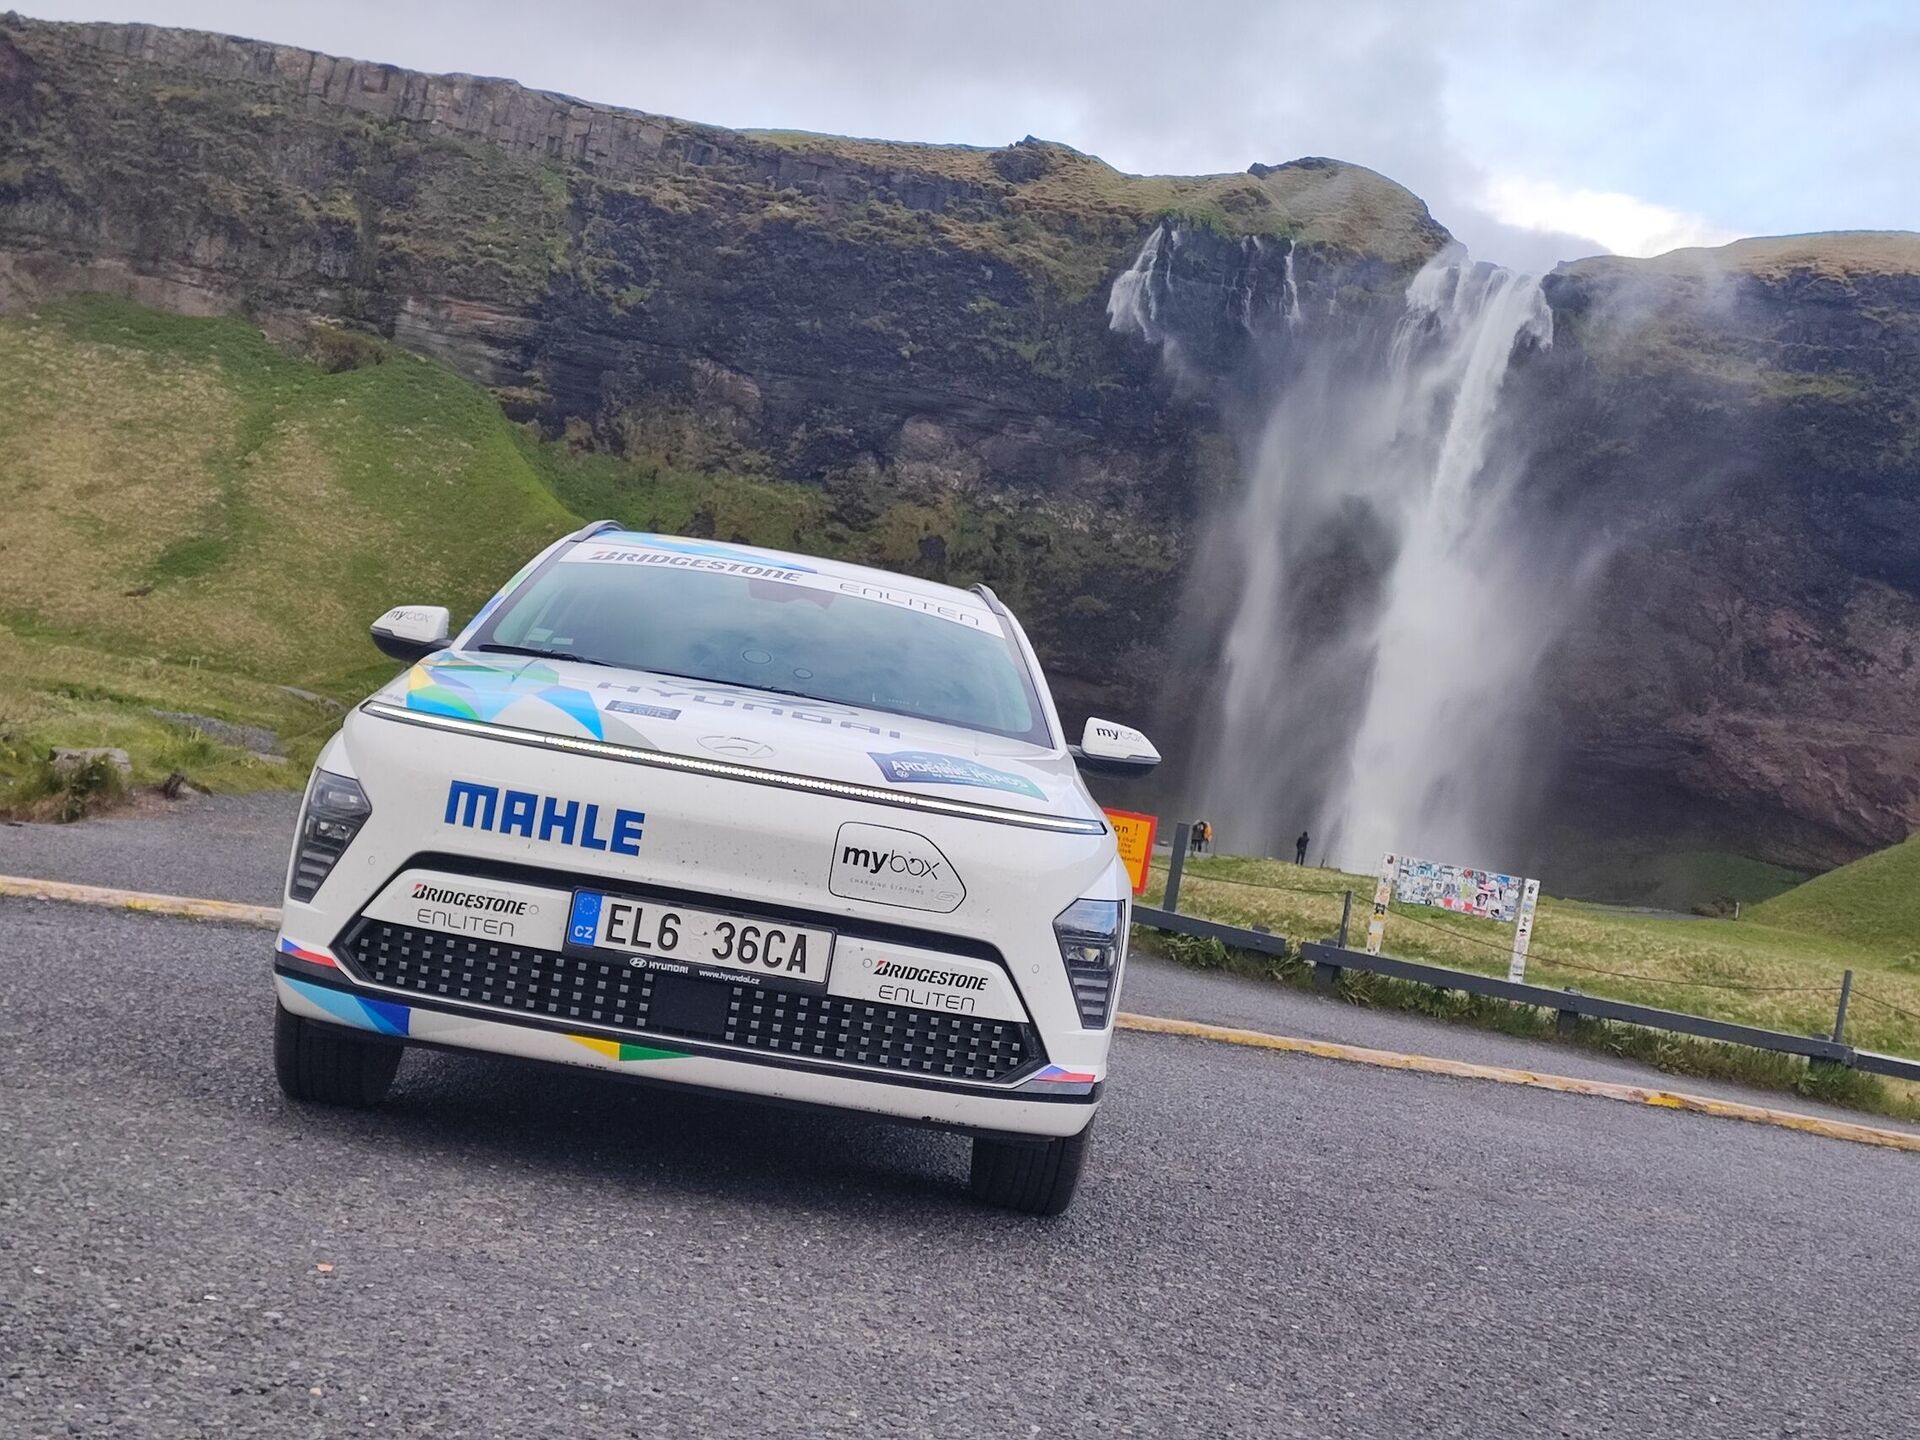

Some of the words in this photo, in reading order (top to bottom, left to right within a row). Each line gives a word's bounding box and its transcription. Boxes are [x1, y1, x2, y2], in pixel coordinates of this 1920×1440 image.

[589, 551, 803, 582] BRIDGESTONE
[840, 583, 979, 626] ENLITEN
[597, 682, 901, 738] HYUNDAI
[890, 760, 970, 777] ARDENNE
[444, 780, 645, 857] MAHLE
[842, 846, 940, 880] mybox
[412, 883, 528, 916] BRIDGESTONE
[417, 908, 515, 937] ENLITEN
[574, 924, 594, 939] CZ
[605, 903, 682, 951] EL6
[711, 921, 807, 974] 36CA
[648, 961, 689, 974] HYUNDAI
[698, 969, 760, 985] www.hyundai.cz
[873, 960, 988, 991] BRIDGESTONE
[879, 984, 975, 1014] ENLITEN
